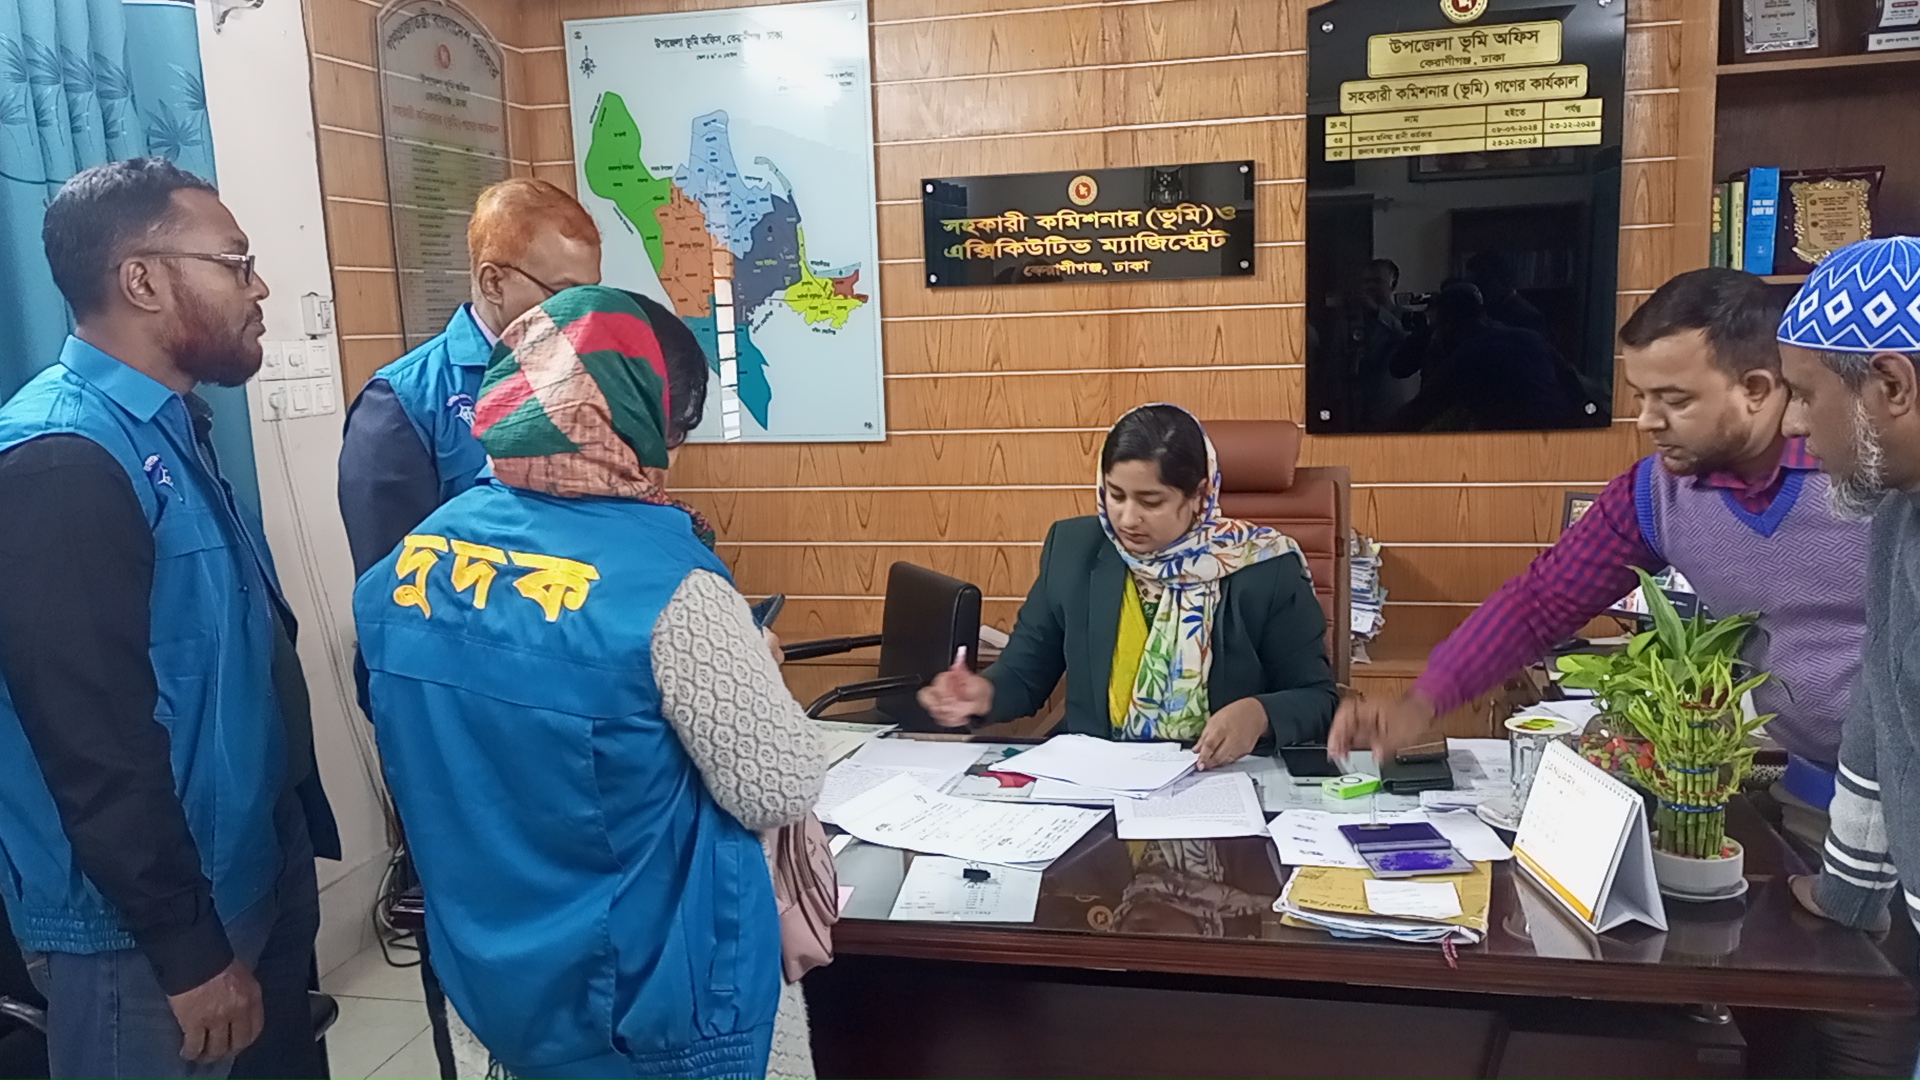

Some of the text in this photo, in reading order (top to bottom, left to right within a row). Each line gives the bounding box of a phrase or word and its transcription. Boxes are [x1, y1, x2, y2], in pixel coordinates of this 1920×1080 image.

[1389, 27, 1540, 54] উপজেলা ভূমি অফিস
[1481, 52, 1506, 64] ঢাকা
[1348, 73, 1580, 104] সহকারী কমিশনার (ভূমি) গণের কার্যকাল
[1404, 115, 1419, 124] নাম
[940, 210, 1027, 236] সহকারী
[1034, 208, 1141, 232] কমিশনার
[1216, 205, 1237, 221] ও
[943, 228, 1229, 261] এক্সিকিউটিভ ম্যাজিস্ট্রেট
[1112, 258, 1151, 274] ঢাকা
[393, 534, 601, 622] দুদক
